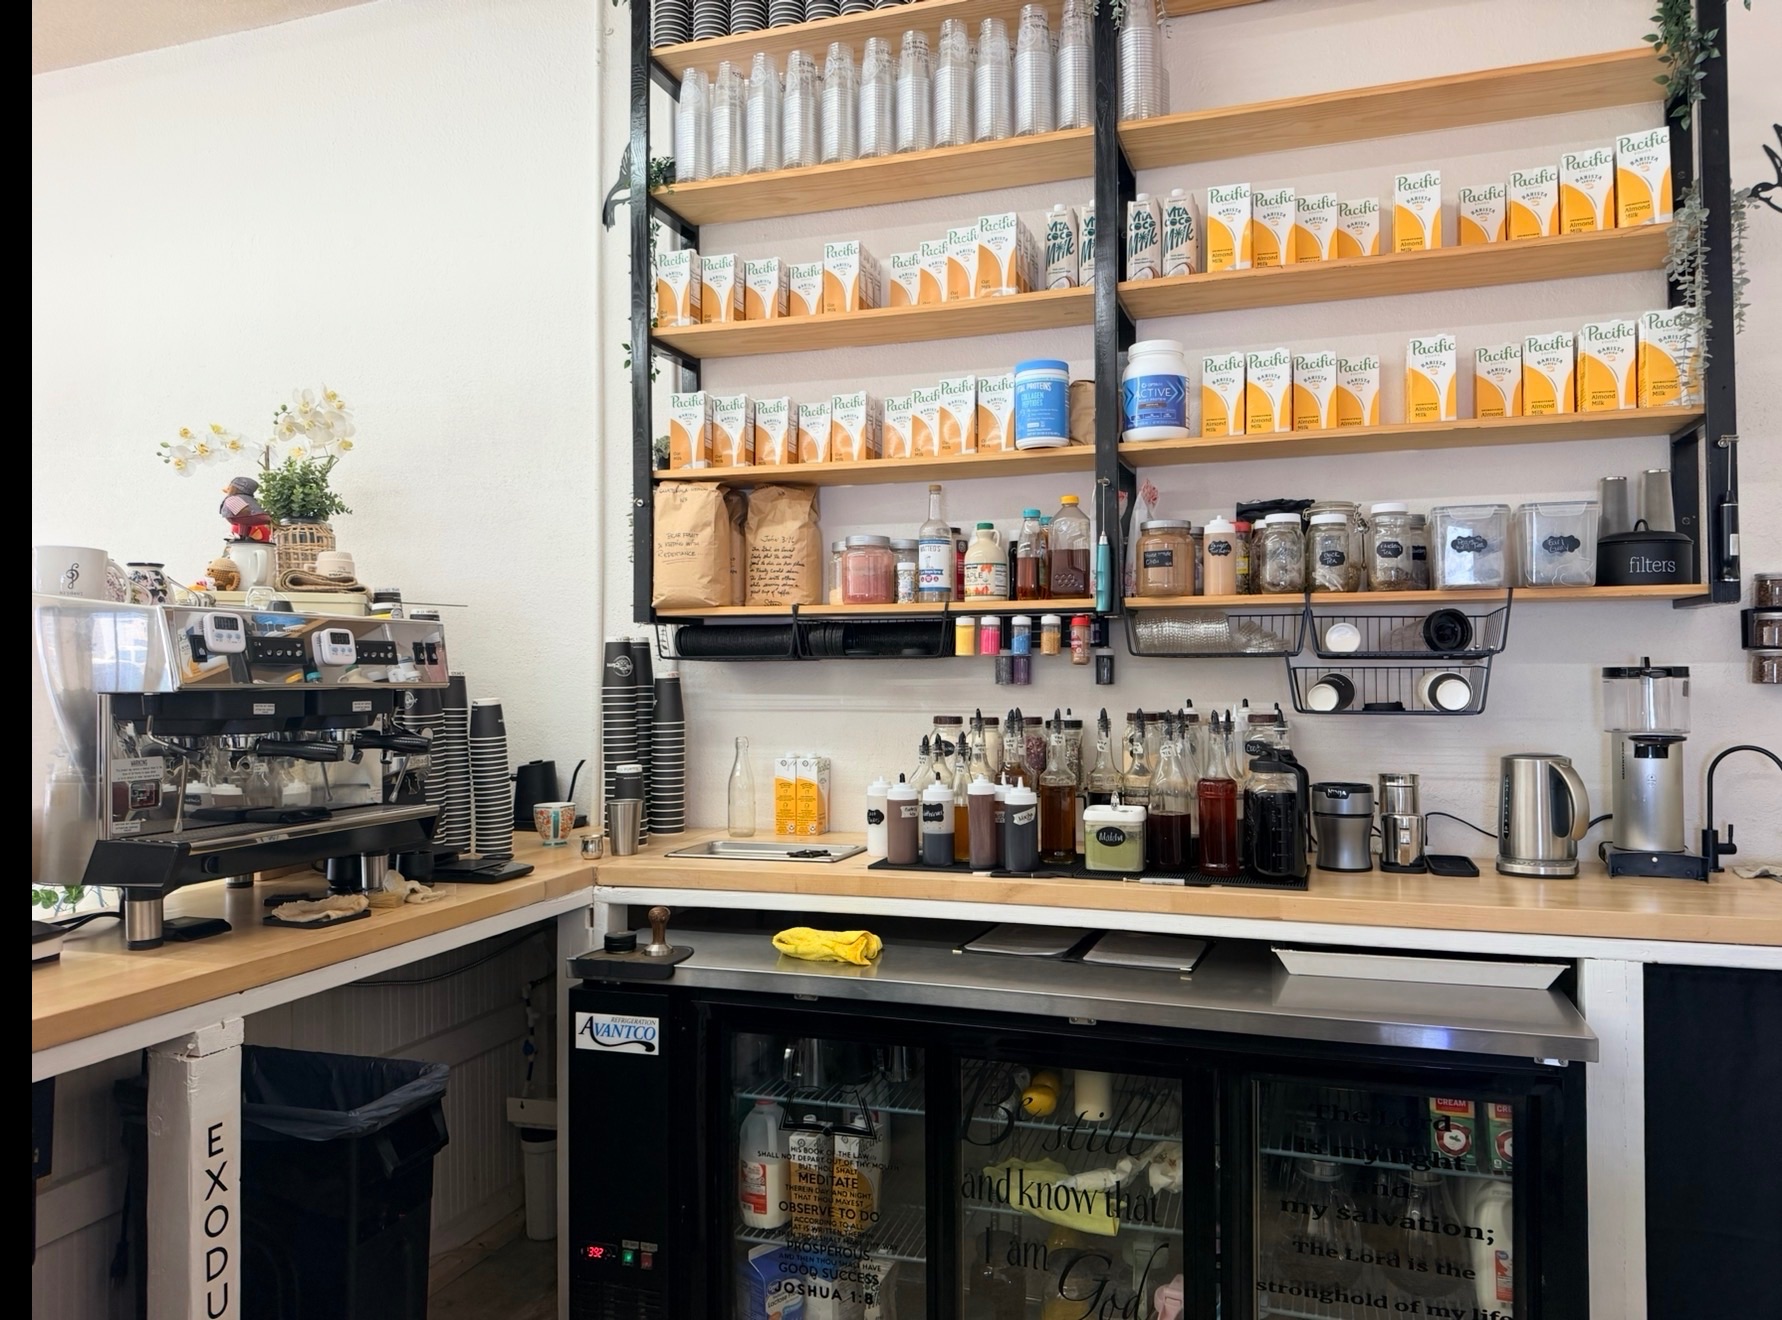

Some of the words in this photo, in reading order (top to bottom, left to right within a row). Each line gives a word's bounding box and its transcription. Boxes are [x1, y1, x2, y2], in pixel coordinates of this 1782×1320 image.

[1617, 131, 1670, 154] Pacific
[1563, 150, 1613, 172] Pacific
[1629, 155, 1659, 166] BARISTA
[1396, 173, 1441, 192] Pacific
[1511, 169, 1558, 189] Pacific
[1575, 174, 1602, 183] BARISTA
[1207, 186, 1251, 204] Pacific
[1253, 190, 1295, 208] Pacific
[1460, 185, 1505, 203] Pacific
[1522, 191, 1547, 200] BARISTA
[1166, 205, 1189, 217] VITA
[1218, 207, 1241, 215] BARISTA
[1295, 195, 1337, 213] Pacific
[1337, 200, 1379, 217] Pacific
[1470, 207, 1495, 215] BARISTA
[1130, 210, 1153, 222] VITA
[1164, 216, 1192, 227] COCO
[1262, 211, 1286, 219] BARISTA
[1305, 216, 1328, 224] BARISTA
[980, 215, 1016, 233] Pacific
[1047, 220, 1069, 231] VITA
[1129, 220, 1156, 231] COCO
[948, 228, 979, 245] Pacifi
[1047, 230, 1073, 241] COCO
[825, 243, 859, 259] Pacific
[921, 240, 948, 257] Pacifi
[658, 252, 689, 267] Pacific
[703, 256, 733, 271] Pacific
[891, 253, 921, 269] Pacifi
[746, 260, 777, 276] Pacific
[790, 264, 822, 280] Pacific
[1585, 323, 1635, 342] Pacific
[1410, 338, 1457, 356] Pacific
[1525, 334, 1574, 353] Pacific
[1597, 346, 1625, 354] BARISTA
[1247, 351, 1291, 369] Pacific
[1475, 345, 1521, 363] Pacific
[1537, 357, 1563, 365] BARISTA
[1203, 356, 1245, 373] Pacific
[1293, 354, 1337, 372] Pacific
[1337, 356, 1379, 374] Pacific
[1486, 367, 1511, 375] BARISTA
[979, 375, 1014, 393] Pacific
[1212, 377, 1235, 385] BARISTA
[1257, 373, 1280, 381] BARISTA
[1346, 377, 1370, 385] BARISTA
[940, 377, 974, 395] Pacific
[1026, 382, 1052, 391] PROTEINS
[1134, 388, 1171, 398] ACTIVE
[1652, 383, 1678, 391] Almond
[671, 394, 705, 408] Pacific
[832, 395, 865, 410] Pacific
[912, 386, 940, 404] Pacifi
[1591, 392, 1616, 400] Almond
[713, 398, 745, 412] Pacific
[756, 400, 788, 415] Pacific
[799, 403, 831, 417] Pacific
[886, 397, 912, 412] Pacifi
[1629, 556, 1676, 574] filters
[966, 571, 983, 579] APLE
[1328, 788, 1347, 797] NINJA
[611, 1017, 657, 1025] REFRIGERATION
[578, 1016, 656, 1052] AVANTCO
[1436, 1097, 1468, 1107] CREAM
[961, 1066, 1042, 1146] Be
[1042, 1088, 1171, 1156] still
[1310, 1103, 1369, 1123] The
[1376, 1110, 1451, 1132] Lord
[757, 1150, 780, 1159] SHALL
[781, 1152, 795, 1160] NOT
[798, 1154, 824, 1163] DEPART
[803, 1147, 823, 1155] BOOK
[838, 1150, 851, 1158] THE
[814, 1164, 833, 1172] THOU
[835, 1167, 857, 1175] SHALT
[785, 1183, 813, 1193] THEREIN
[798, 1172, 859, 1189] MEDITATE
[794, 1192, 812, 1201] THAT
[835, 1198, 864, 1207] MAYEST
[961, 1168, 1011, 1205] and
[1019, 1169, 1108, 1214] know
[1105, 1181, 1160, 1223] that
[778, 1201, 836, 1218] OBSERVE
[839, 1208, 856, 1220] TO
[860, 1210, 880, 1223] DO
[204, 1122, 229, 1320] EXODU
[794, 1215, 837, 1228] ACCORDING
[839, 1220, 849, 1228] TO
[850, 1222, 864, 1231] ALL
[1281, 1199, 1328, 1220] my
[1336, 1205, 1494, 1245] salvation;
[786, 1240, 873, 1262] PROSPEROUS,
[778, 1253, 795, 1261] AND
[796, 1254, 815, 1263] THEN
[816, 1257, 837, 1266] THOU
[862, 1263, 881, 1272] HAVE
[1293, 1240, 1339, 1259] The
[1346, 1247, 1401, 1269] Lord
[1408, 1257, 1428, 1272] is
[1436, 1261, 1476, 1280] the
[779, 1262, 818, 1277] GOOD
[822, 1268, 882, 1286] SUCCESS.
[985, 1227, 991, 1264] I
[1007, 1240, 1049, 1271] am
[1059, 1243, 1169, 1320] God
[774, 1281, 842, 1301] JOSHUA
[851, 1291, 874, 1306] 1:8
[1256, 1279, 1388, 1309] stronghold
[1394, 1299, 1421, 1312] of
[1426, 1306, 1472, 1320] my
